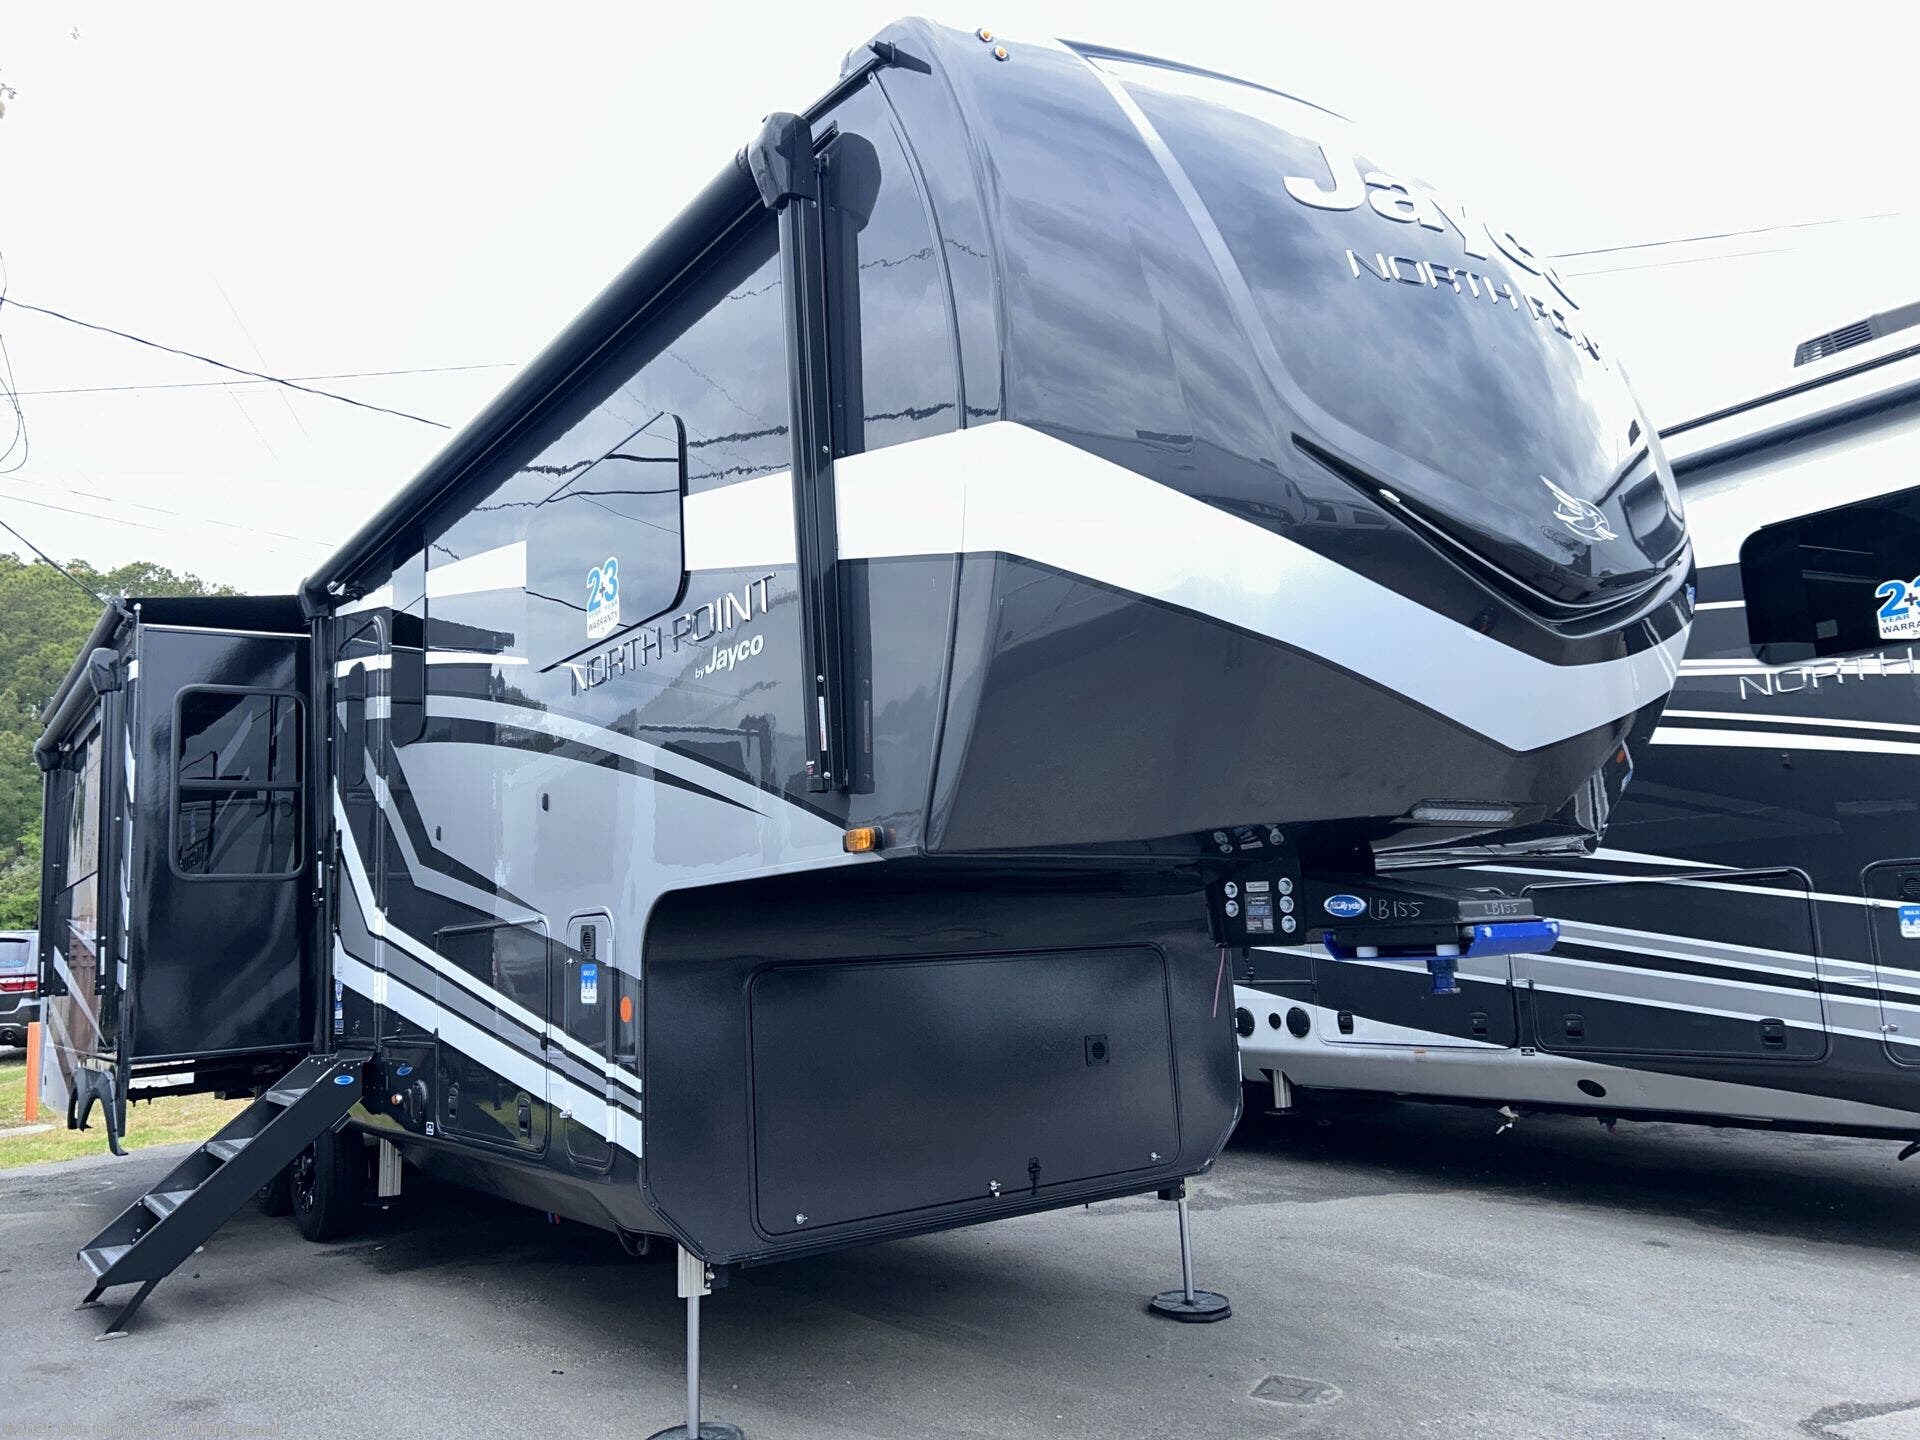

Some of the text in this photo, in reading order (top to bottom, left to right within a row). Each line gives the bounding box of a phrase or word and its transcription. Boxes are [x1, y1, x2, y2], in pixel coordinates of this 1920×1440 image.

[1345, 249, 1519, 311] NORTH
[571, 572, 776, 696] NORTH POINT
[588, 611, 618, 632] WARRANTY
[1881, 614, 1910, 623] YEAR
[695, 634, 764, 680] by Jayco
[1739, 647, 1915, 700] NORTH
[1368, 896, 1424, 920] LB155
[1484, 902, 1519, 916] LB155
